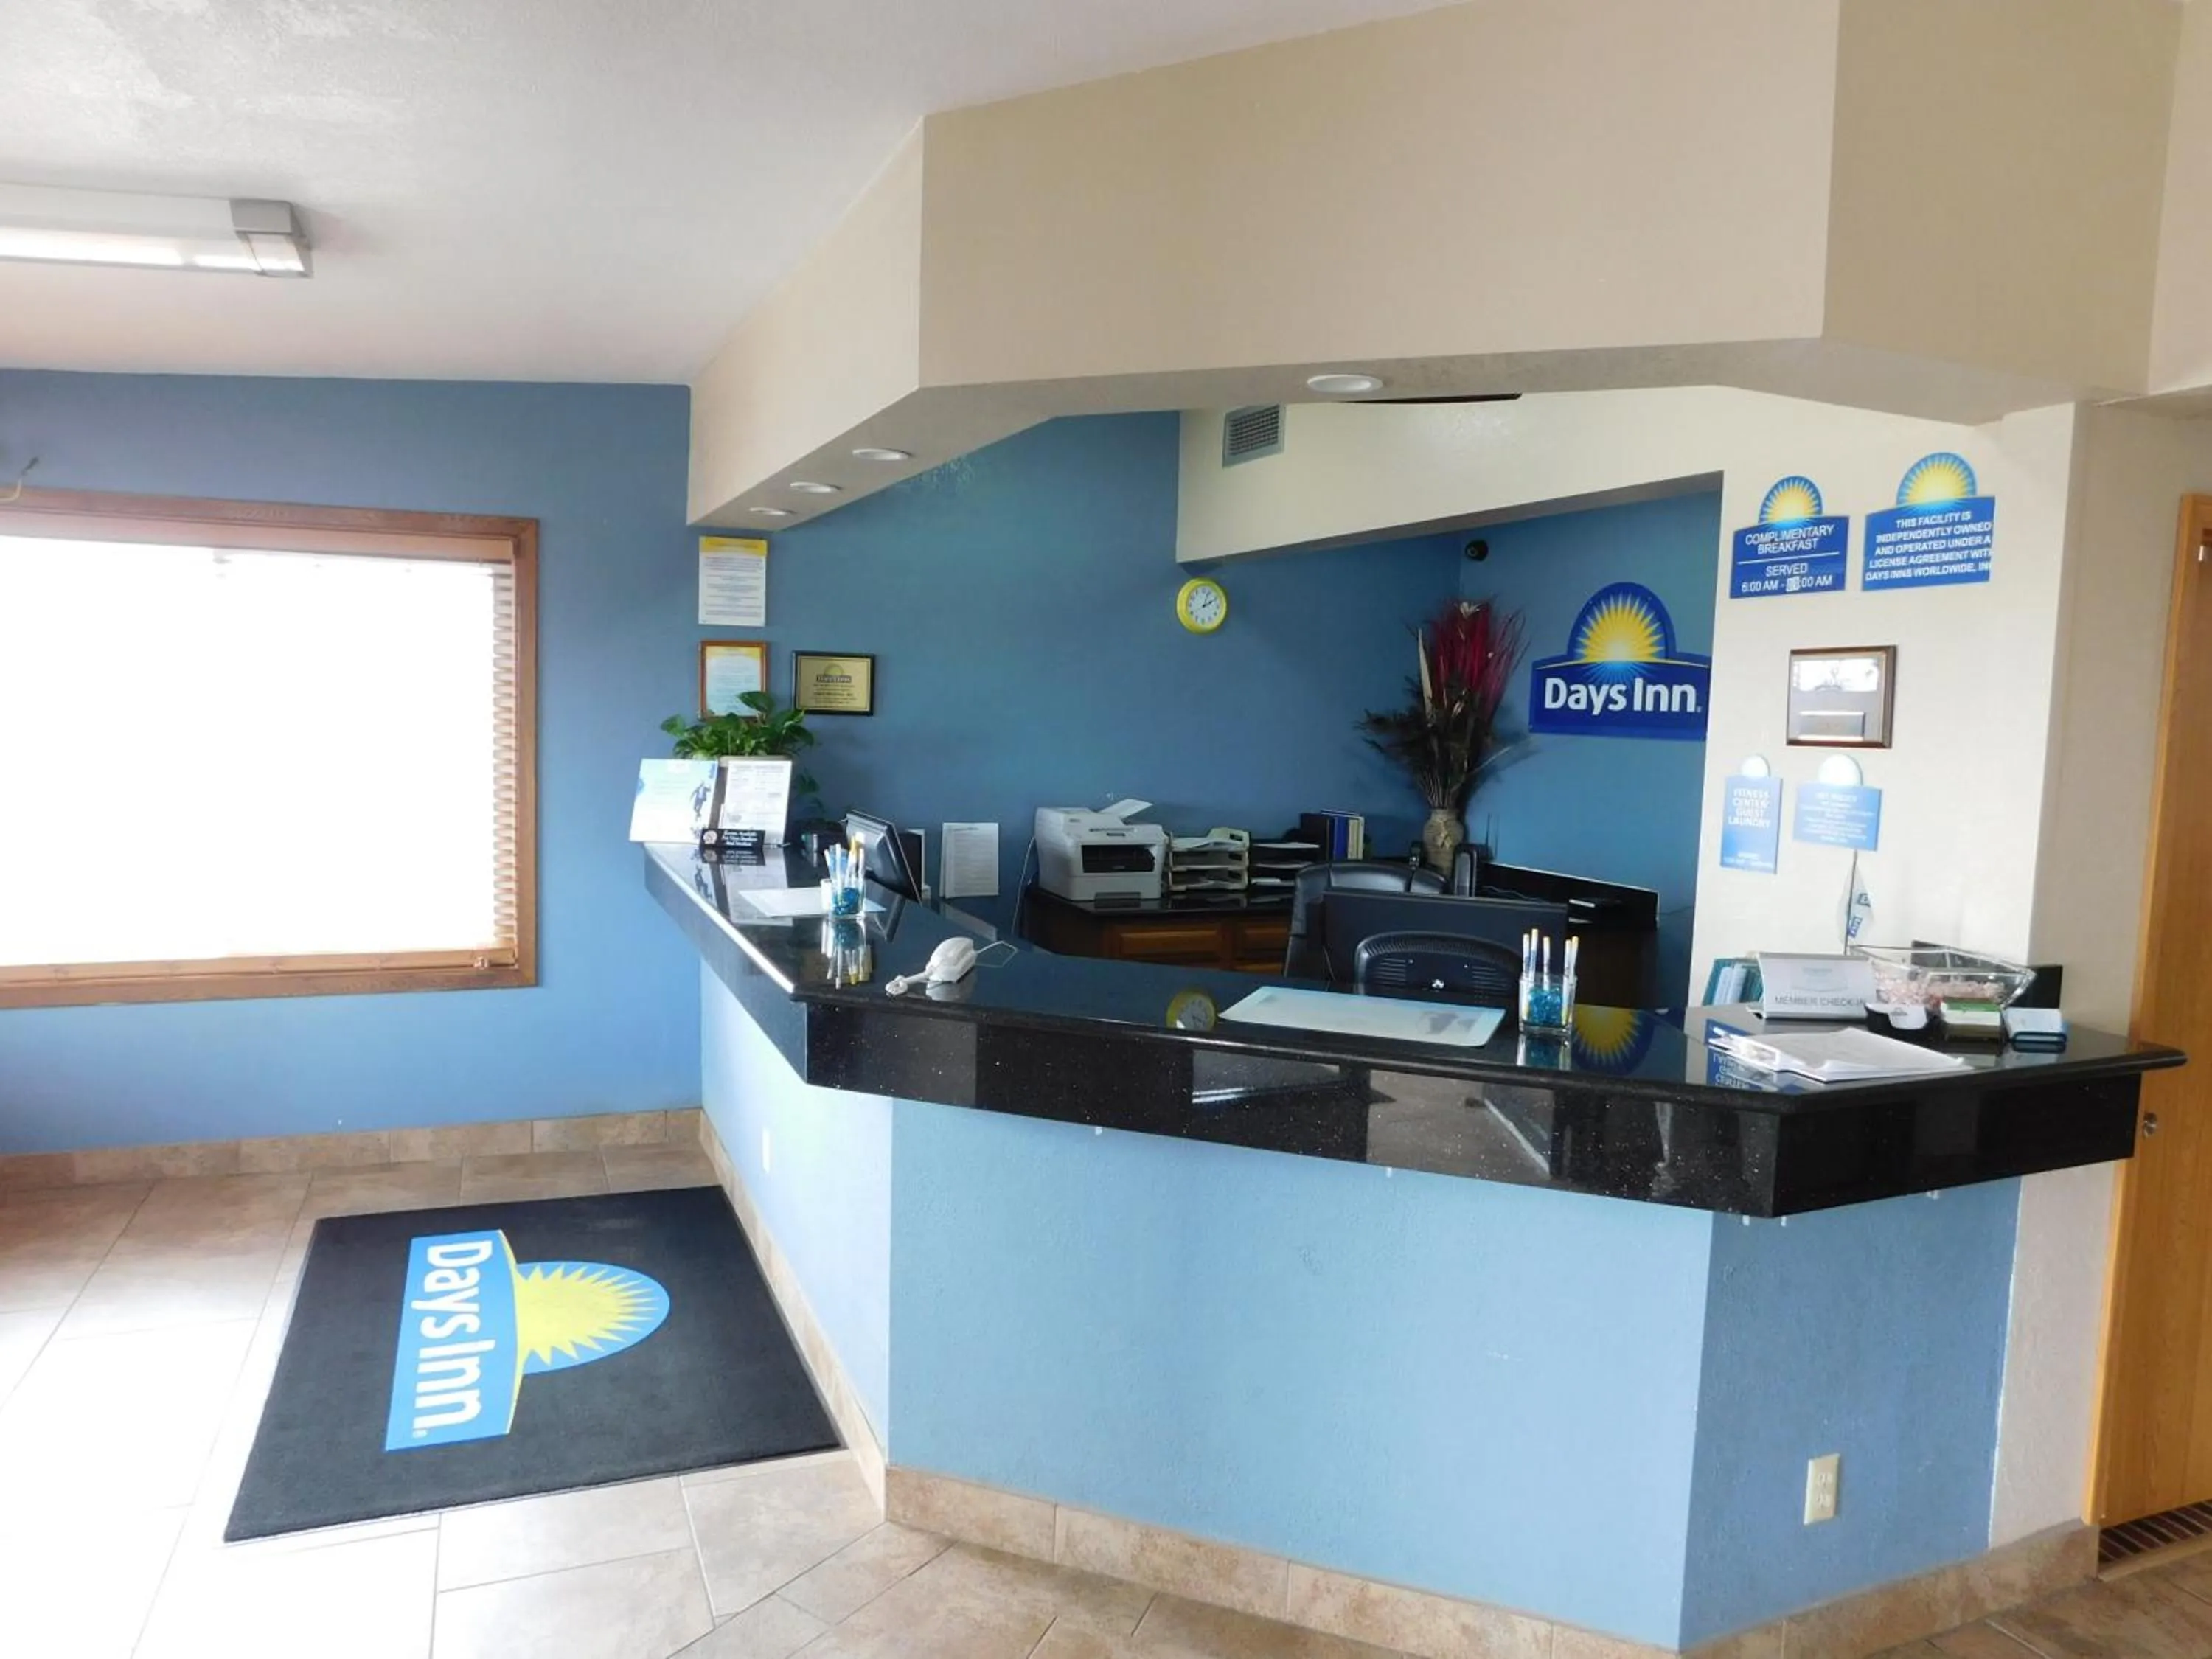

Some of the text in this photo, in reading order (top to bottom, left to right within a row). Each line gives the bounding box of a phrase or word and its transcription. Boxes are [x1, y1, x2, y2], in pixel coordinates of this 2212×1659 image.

[1896, 511, 1972, 529] THIS FACILITY IS
[1745, 525, 1834, 545] COMPLIMENTARY
[1876, 521, 1991, 543] INDEPENDENTLY OWNED
[1757, 538, 1818, 554] BREAKFAST
[1875, 535, 1991, 556] AND OPERATED UNDER A
[1869, 557, 1907, 568] LICENSE
[1908, 550, 1969, 566] AGREEMENT
[1765, 563, 1808, 577] SERVED
[1865, 569, 1889, 581] DAYS
[1890, 567, 1912, 579] INNS
[1741, 580, 1761, 593] 6:00
[1763, 580, 1778, 591] AM
[1815, 575, 1832, 586] AM
[1545, 678, 1697, 716] Days Inn
[411, 1240, 495, 1430] Days Inn
